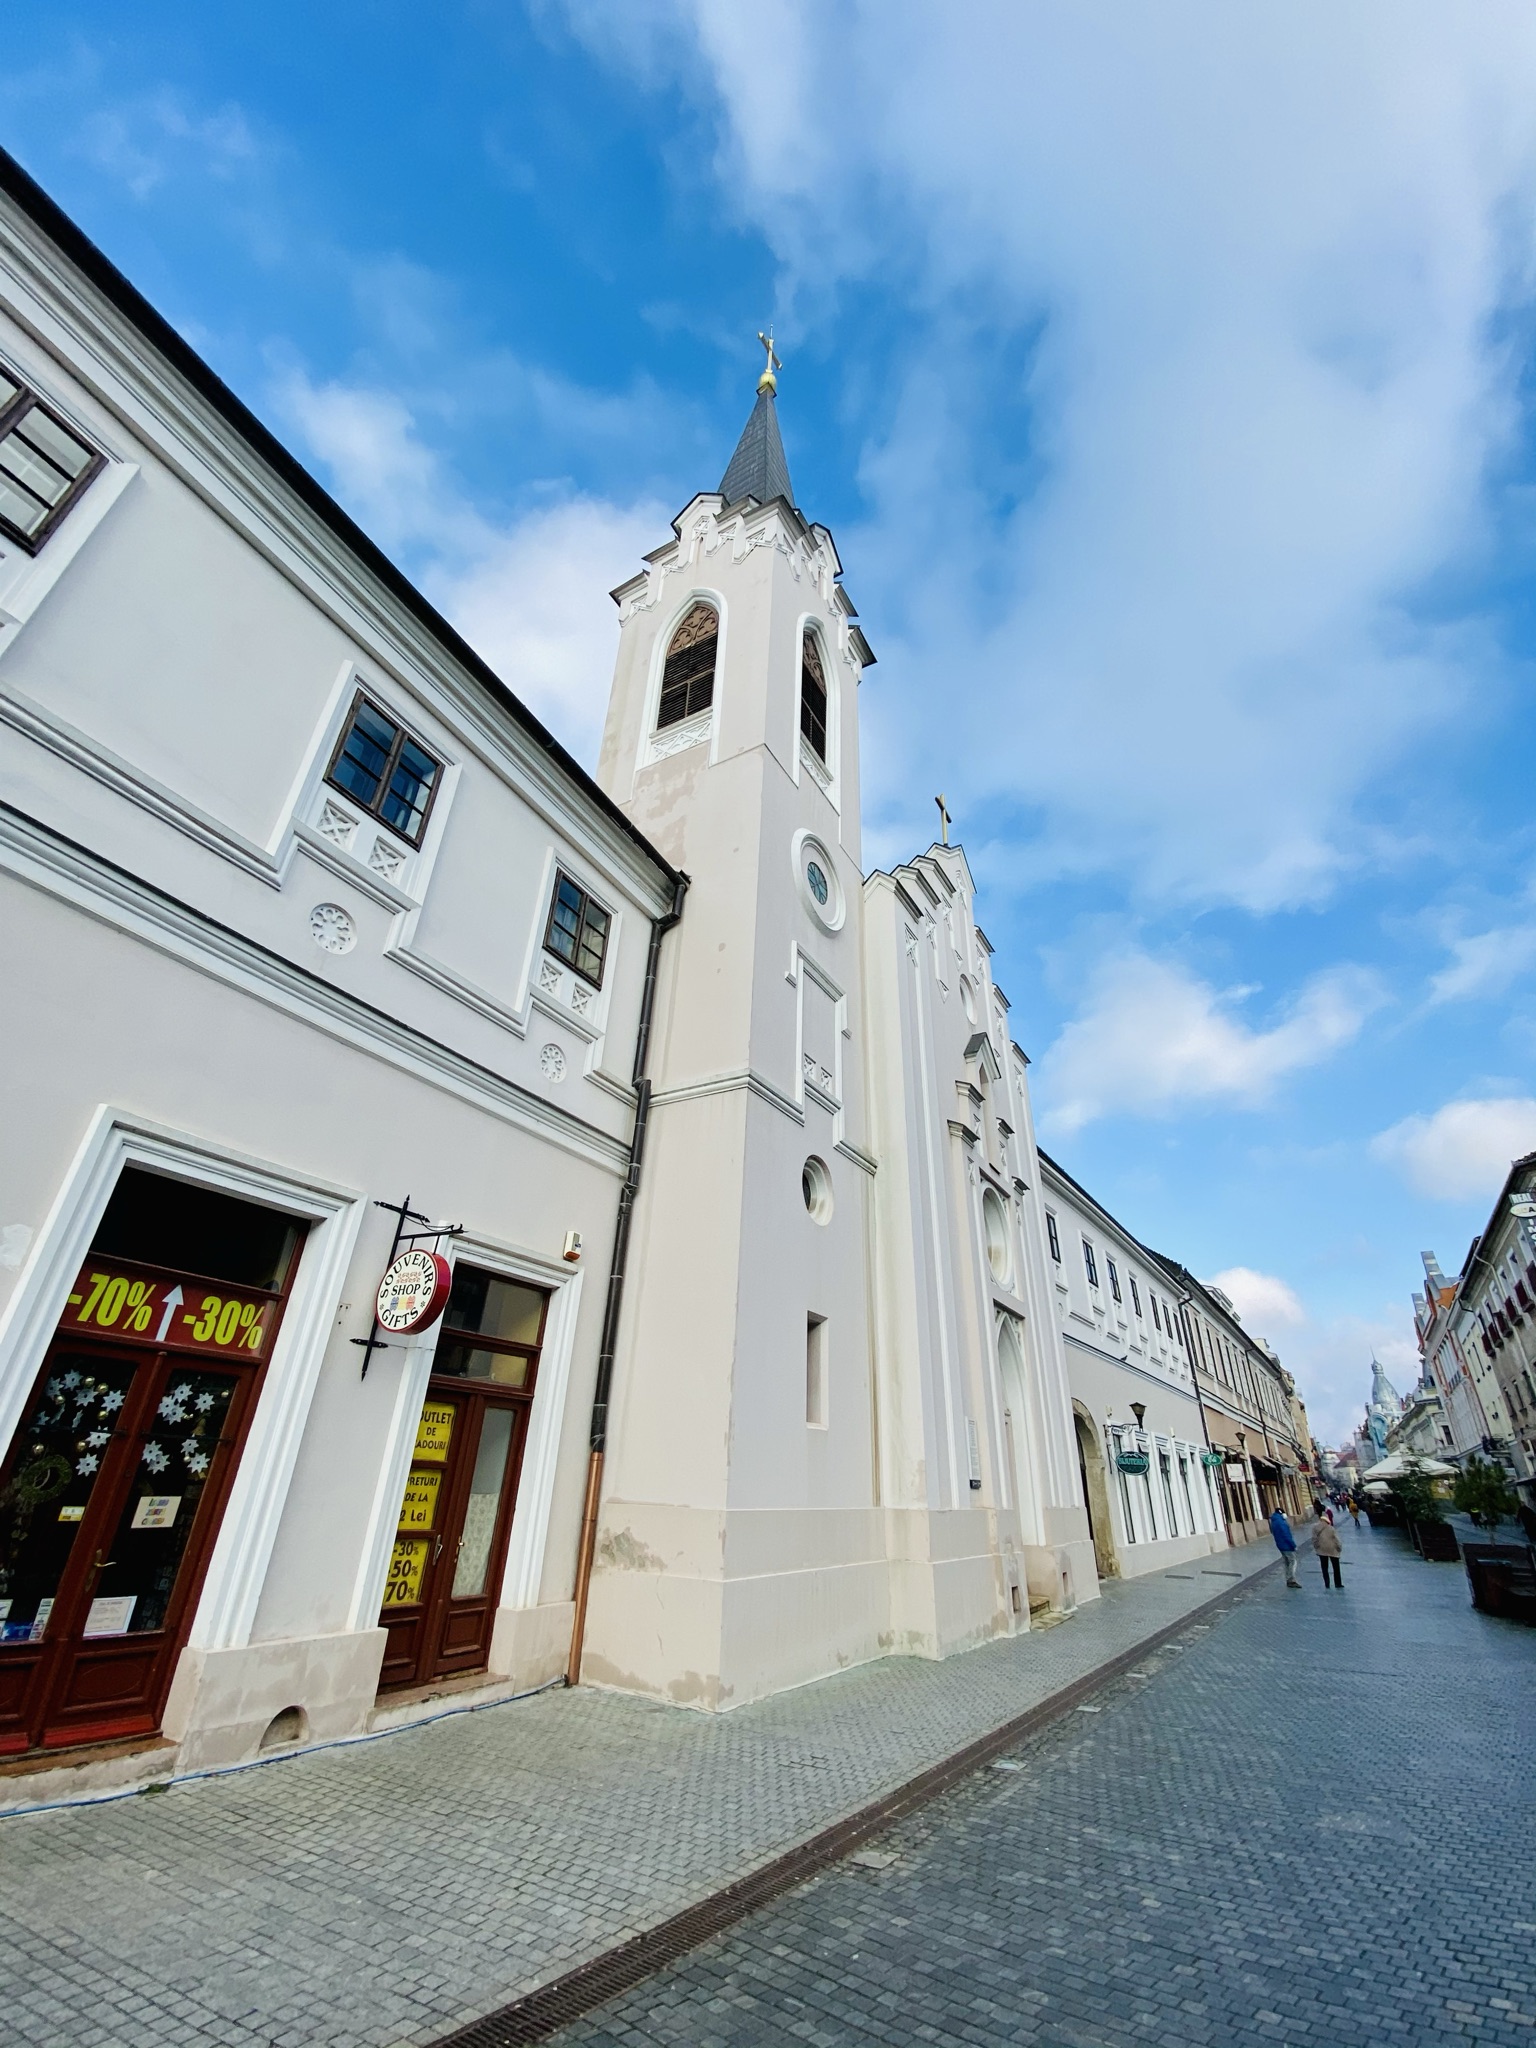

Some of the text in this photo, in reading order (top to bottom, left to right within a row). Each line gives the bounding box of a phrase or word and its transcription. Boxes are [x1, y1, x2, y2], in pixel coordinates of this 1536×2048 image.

[380, 1253, 434, 1298] SOUVENIRS
[391, 1284, 421, 1296] SHOP
[68, 1273, 265, 1350] -70% -30%
[381, 1307, 419, 1327] GIFTS
[426, 1426, 437, 1437] DE
[407, 1476, 438, 1487] RETURI
[404, 1492, 429, 1503] DE LA
[411, 1509, 427, 1522] Lei
[394, 1540, 419, 1557] -30%
